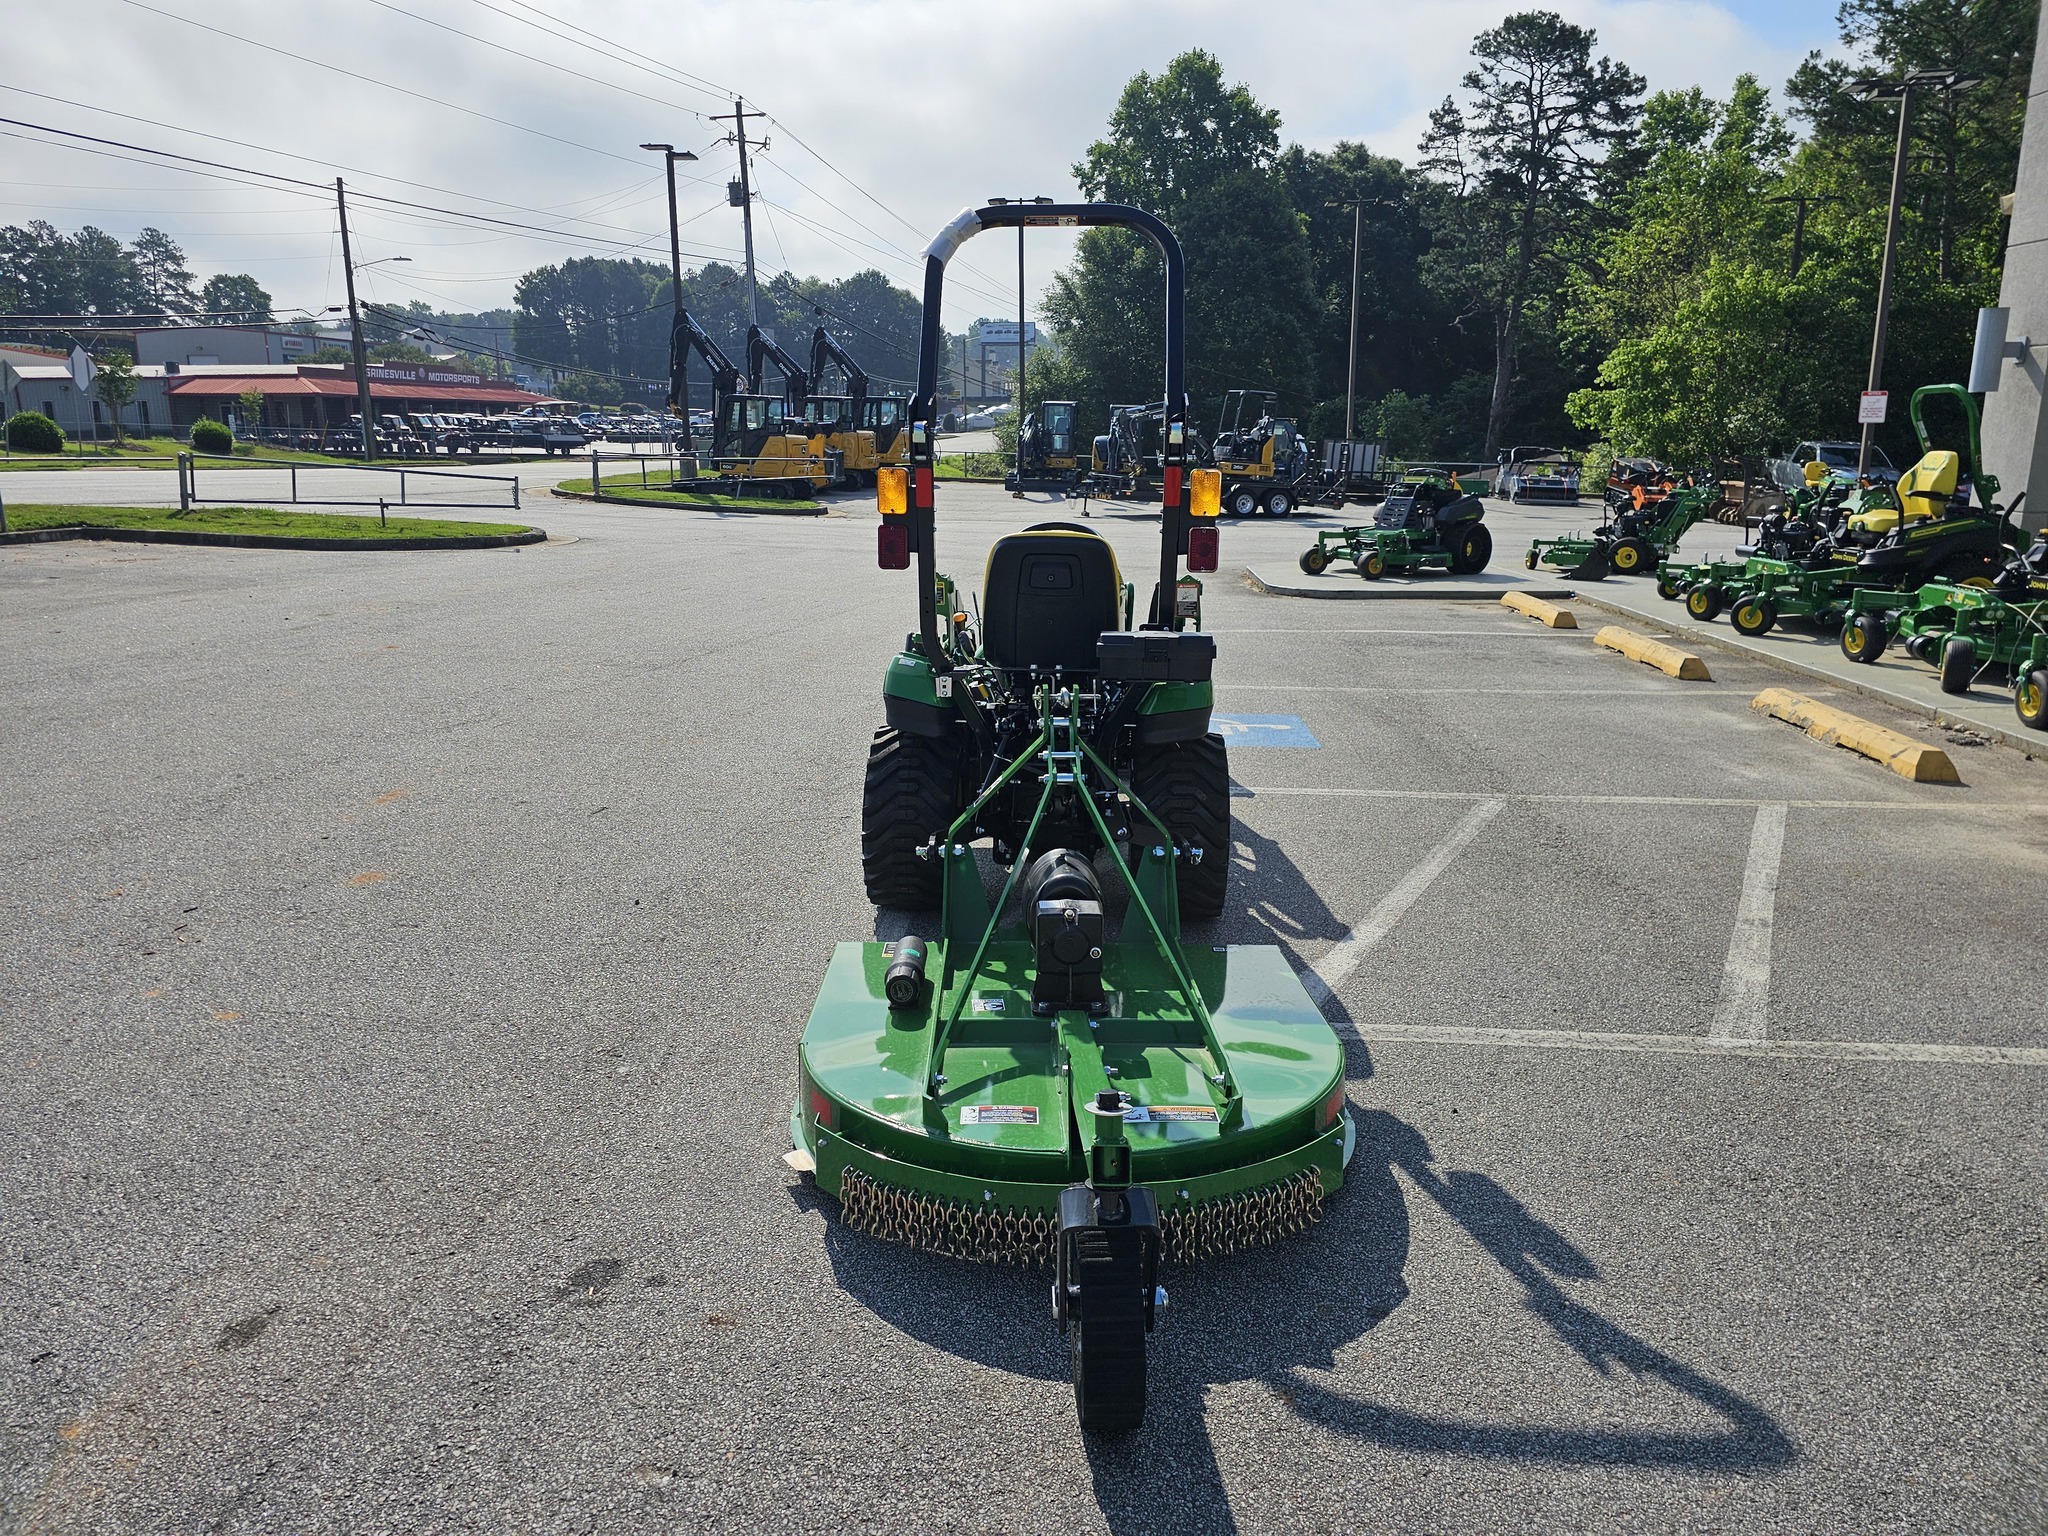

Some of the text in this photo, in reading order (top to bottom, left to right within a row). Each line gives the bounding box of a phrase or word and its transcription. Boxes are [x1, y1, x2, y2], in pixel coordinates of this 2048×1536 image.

[706, 354, 720, 373] DEERE
[778, 362, 792, 378] DEERE
[428, 372, 480, 384] MOTORSPORTS
[1831, 552, 1858, 563] JOHN DEERE
[2029, 580, 2046, 589] JOHN
